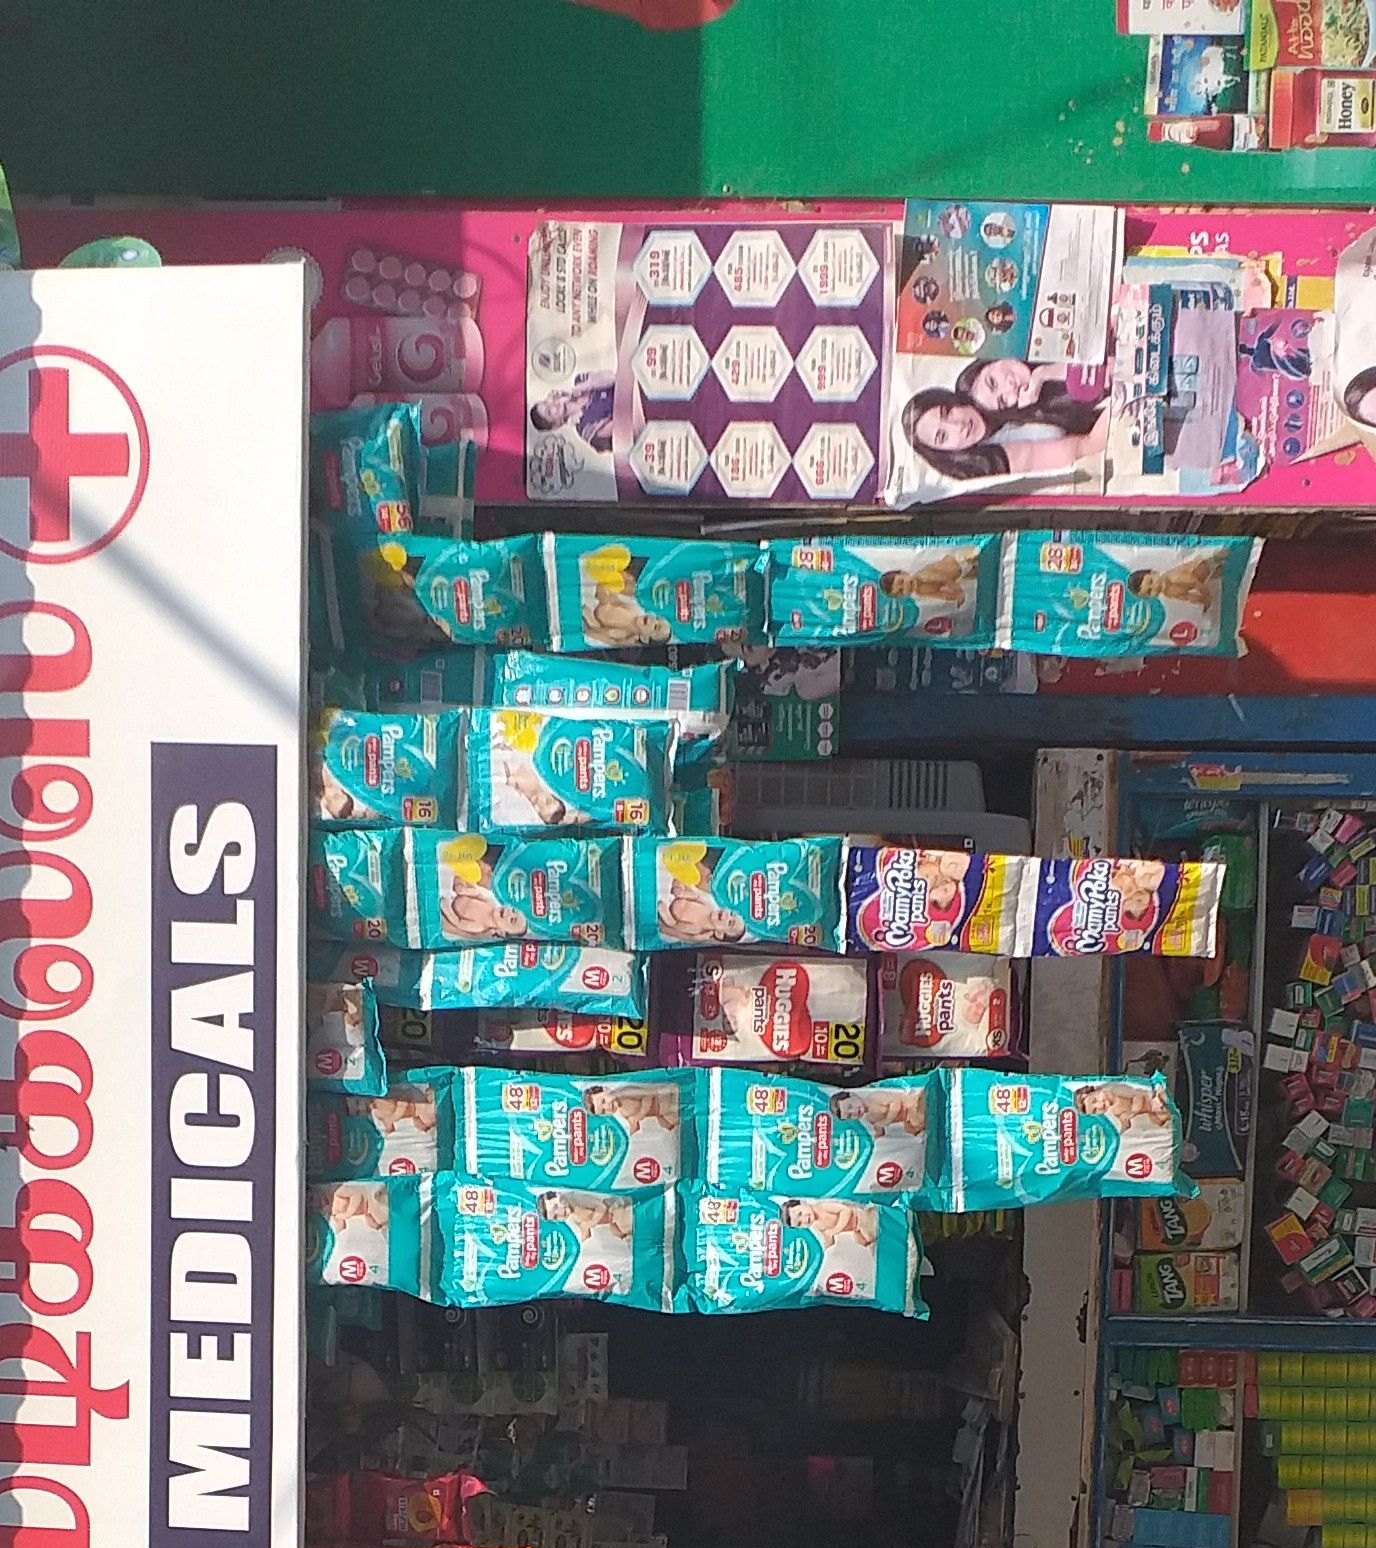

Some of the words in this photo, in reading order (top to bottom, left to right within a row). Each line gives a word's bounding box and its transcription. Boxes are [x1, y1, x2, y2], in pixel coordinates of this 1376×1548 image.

[1337, 81, 1357, 130] Honey
[1047, 548, 1063, 571] 28
[832, 574, 859, 637] Pampers
[1076, 573, 1104, 640] Pampers
[379, 723, 403, 794] Pampers
[590, 726, 615, 798] Pampers
[628, 801, 644, 821] 16
[546, 860, 567, 925] Pampers
[766, 862, 788, 926] Pampers
[883, 847, 917, 945] MamyPoko
[910, 879, 927, 923] pants
[1068, 859, 1111, 953] MamyPoko
[1103, 890, 1121, 933] pants
[751, 986, 767, 1033] pants
[772, 967, 796, 1051] HUGGIES
[917, 971, 934, 1037] HUGGIES
[935, 980, 955, 1032] pants
[833, 1022, 861, 1060] 20
[509, 1086, 523, 1111] 48
[754, 1089, 768, 1113] 48
[996, 1088, 1012, 1113] 48
[1193, 1070, 1219, 1132] whisper
[544, 1099, 568, 1177] Pampers
[571, 1111, 584, 1147] pants
[789, 1104, 813, 1180] Pampers
[816, 1114, 830, 1150] pants
[1036, 1100, 1060, 1175] Pampers
[1061, 1111, 1075, 1147] pants
[167, 799, 258, 1533] MEDICALS
[638, 1161, 652, 1179] M
[880, 1166, 895, 1184] M
[1128, 1158, 1144, 1176] M
[464, 1190, 479, 1214] 48
[706, 1202, 721, 1223] 48
[1159, 1199, 1185, 1240] TANG
[500, 1203, 522, 1279] Pampers
[524, 1215, 537, 1252] pants
[741, 1212, 765, 1290] Pampers
[766, 1223, 779, 1260] pants
[341, 1260, 357, 1279] M
[586, 1268, 600, 1287] M
[1158, 1264, 1184, 1304] TANG
